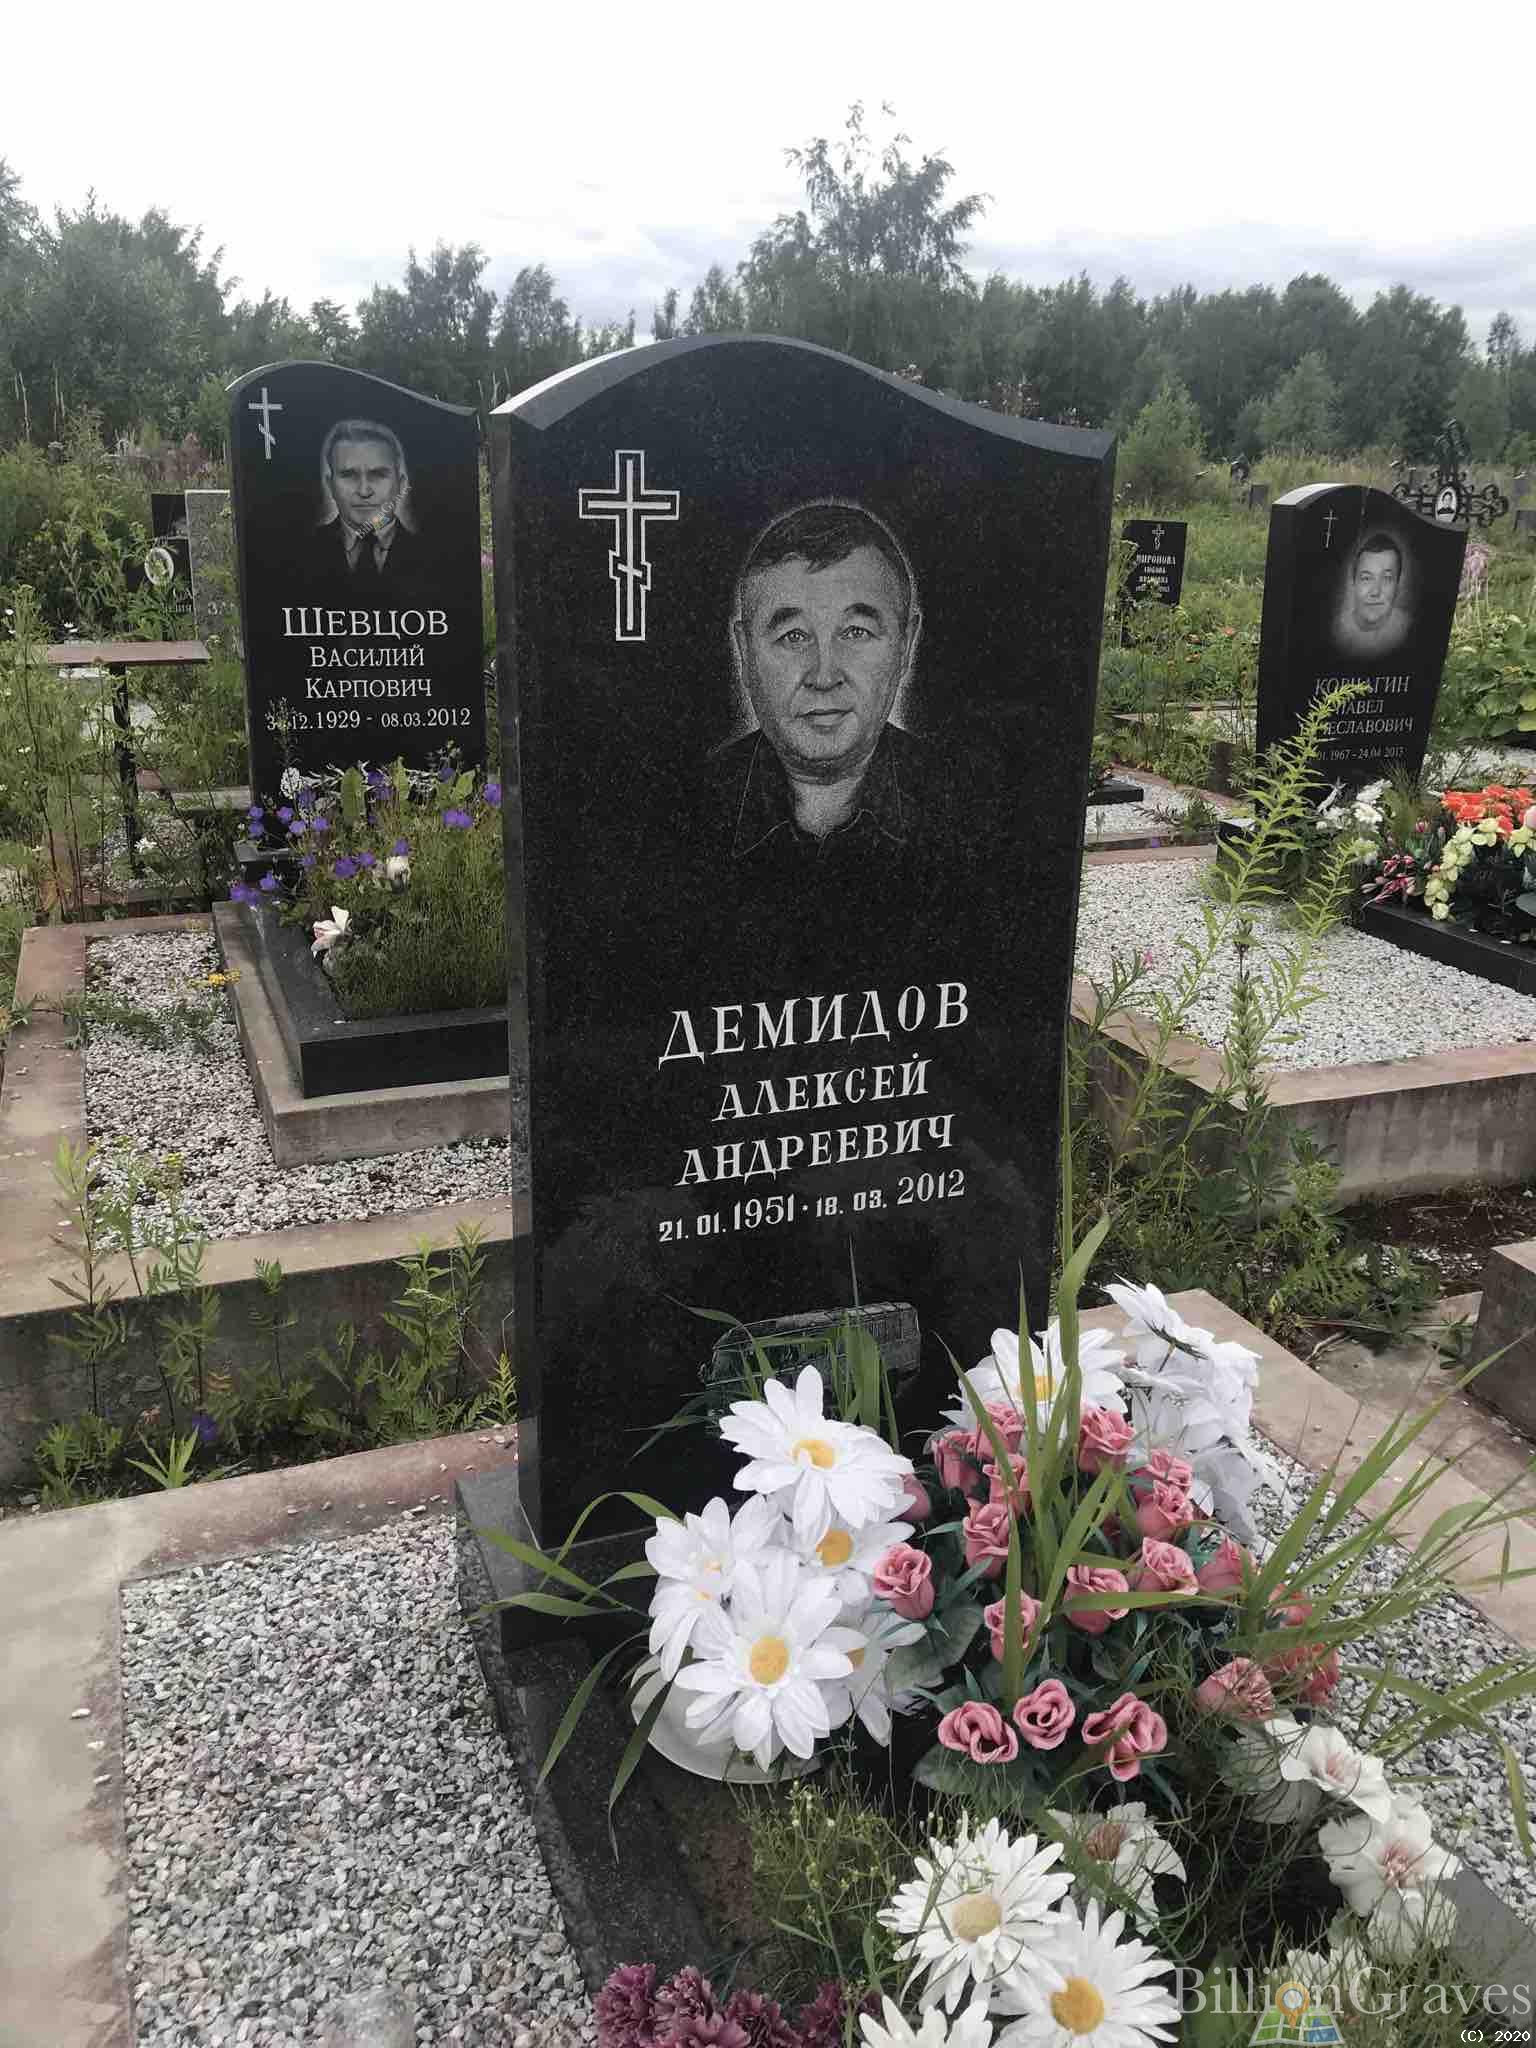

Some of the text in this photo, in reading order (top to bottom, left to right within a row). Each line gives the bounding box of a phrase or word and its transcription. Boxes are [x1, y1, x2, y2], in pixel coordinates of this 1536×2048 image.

[267, 710, 360, 729] 312.1929
[381, 708, 471, 728] 08.03.2012
[658, 982, 969, 1070] ДЕМИДОВ
[712, 1052, 932, 1122] АЛЕКСЕЙ
[674, 1114, 955, 1186] АНДРЕЕВИЧ
